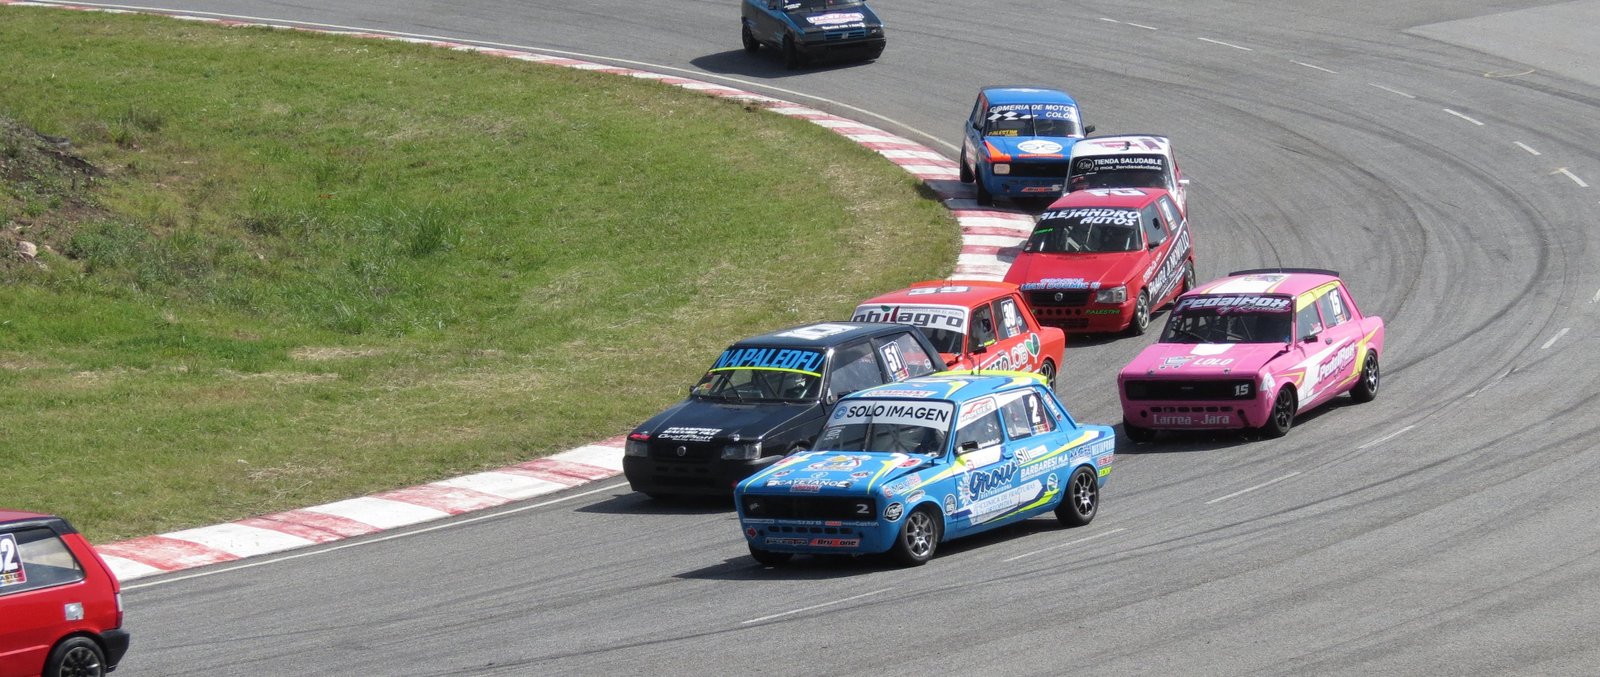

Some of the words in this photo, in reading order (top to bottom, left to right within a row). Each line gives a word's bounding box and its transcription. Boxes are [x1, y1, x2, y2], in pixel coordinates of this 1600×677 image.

[1120, 157, 1162, 165] SALUDABLE
[1040, 208, 1141, 220] ALEJANDRO
[1080, 217, 1136, 226] AUTOS
[1004, 303, 1016, 328] 39
[715, 348, 825, 372] NAPALEOFU
[884, 346, 901, 370] 51
[1234, 384, 1249, 396] 15
[846, 405, 885, 418] SOLO
[885, 405, 949, 422] IMAGEN
[1028, 394, 1042, 424] 2
[1153, 414, 1192, 424] Larrea
[1201, 414, 1230, 424] Jara
[856, 503, 870, 514] 2
